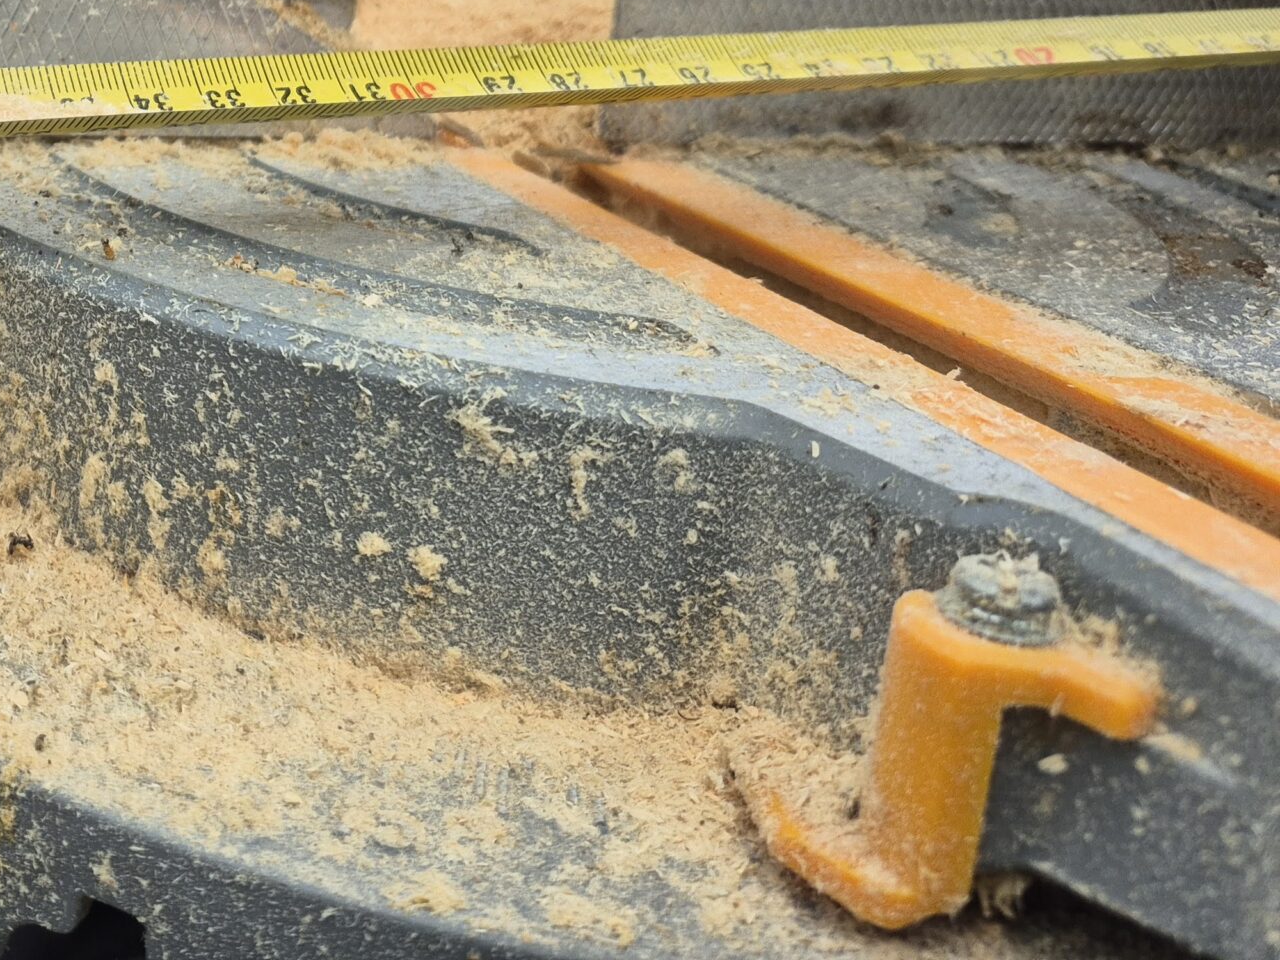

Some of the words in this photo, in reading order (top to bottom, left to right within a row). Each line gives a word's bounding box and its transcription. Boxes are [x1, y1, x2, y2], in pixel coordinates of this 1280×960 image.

[549, 71, 589, 91] 28
[619, 67, 655, 89] 27
[677, 65, 717, 85] 26
[203, 89, 247, 109] 33
[274, 85, 317, 105] 32
[347, 82, 387, 103] 31
[389, 81, 437, 102] 30
[132, 92, 174, 112] 34
